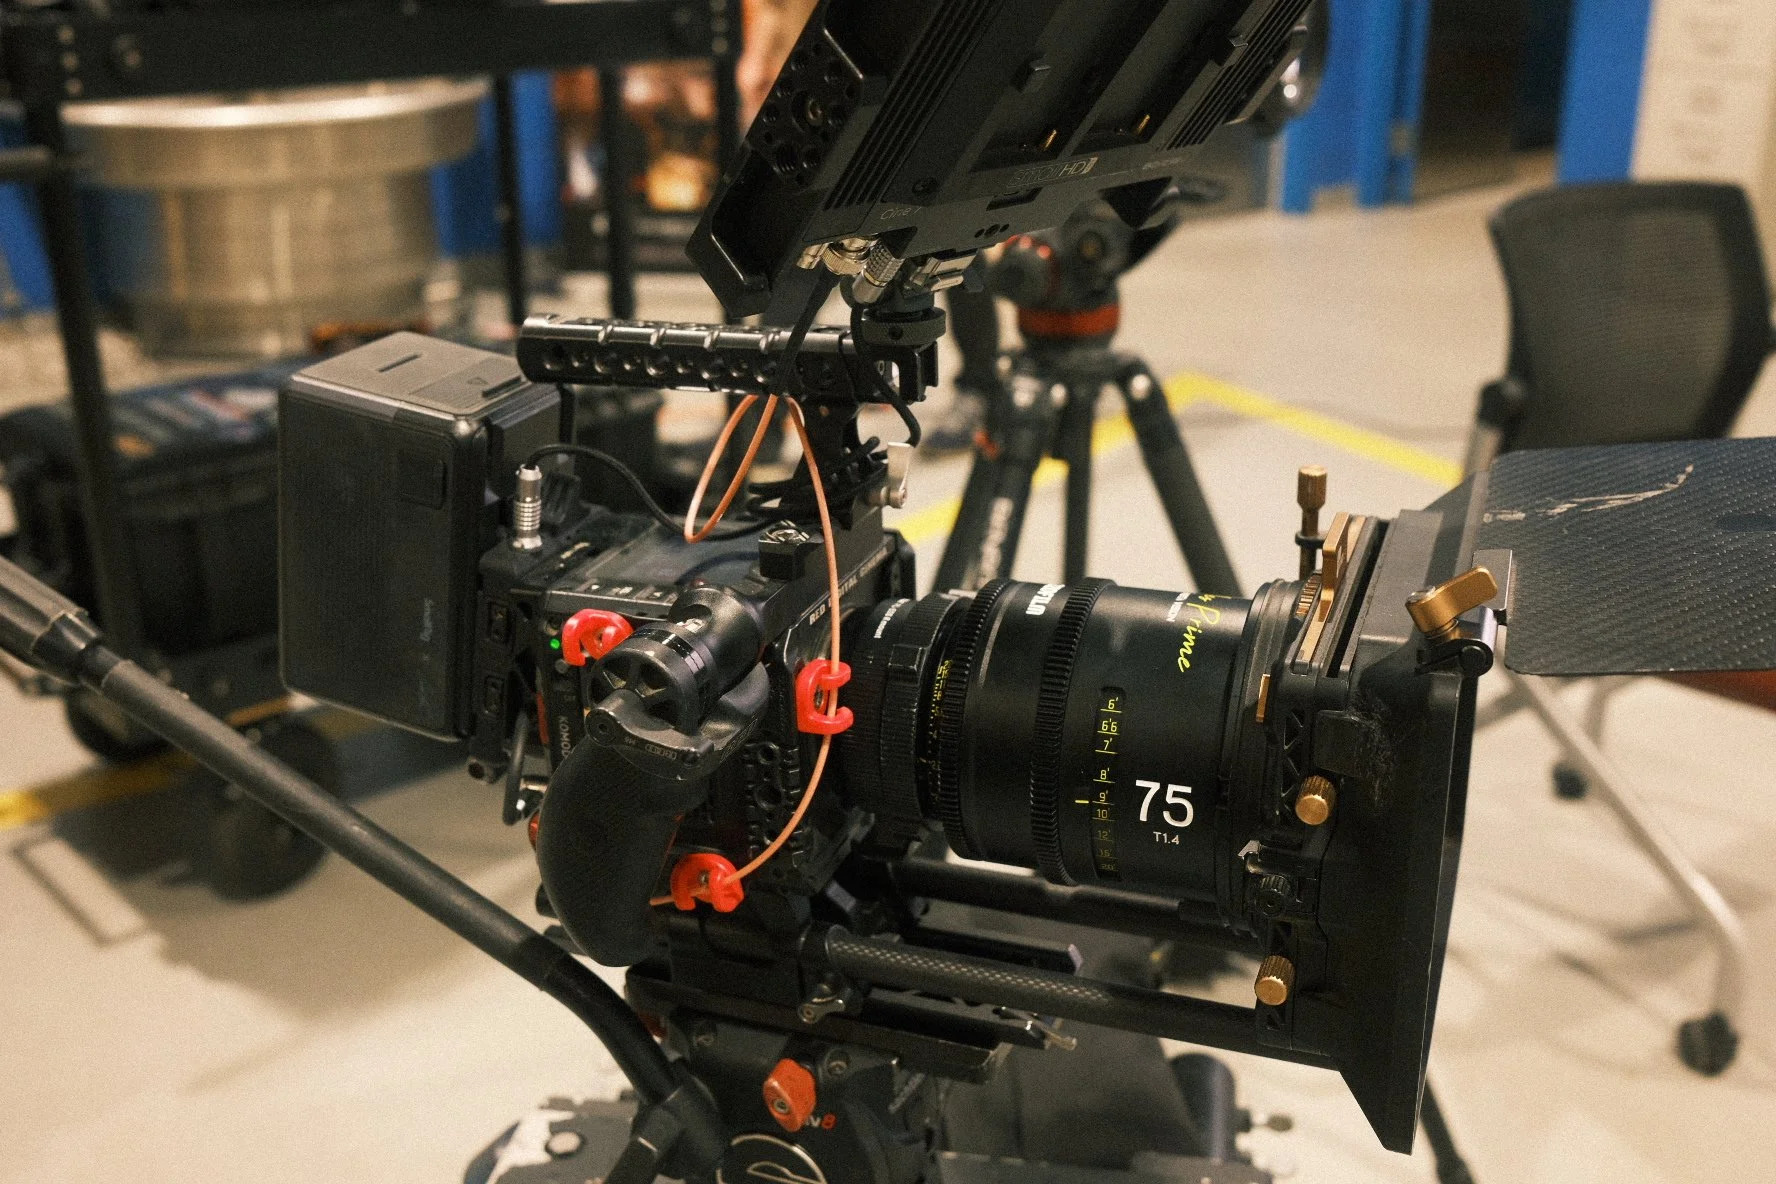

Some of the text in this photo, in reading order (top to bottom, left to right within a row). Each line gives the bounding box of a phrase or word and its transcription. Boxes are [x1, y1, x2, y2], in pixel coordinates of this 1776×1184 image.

[809, 604, 826, 626] RED
[558, 715, 572, 760] KOMOD
[1135, 779, 1194, 828] 75
[1153, 831, 1180, 845] T1.4
